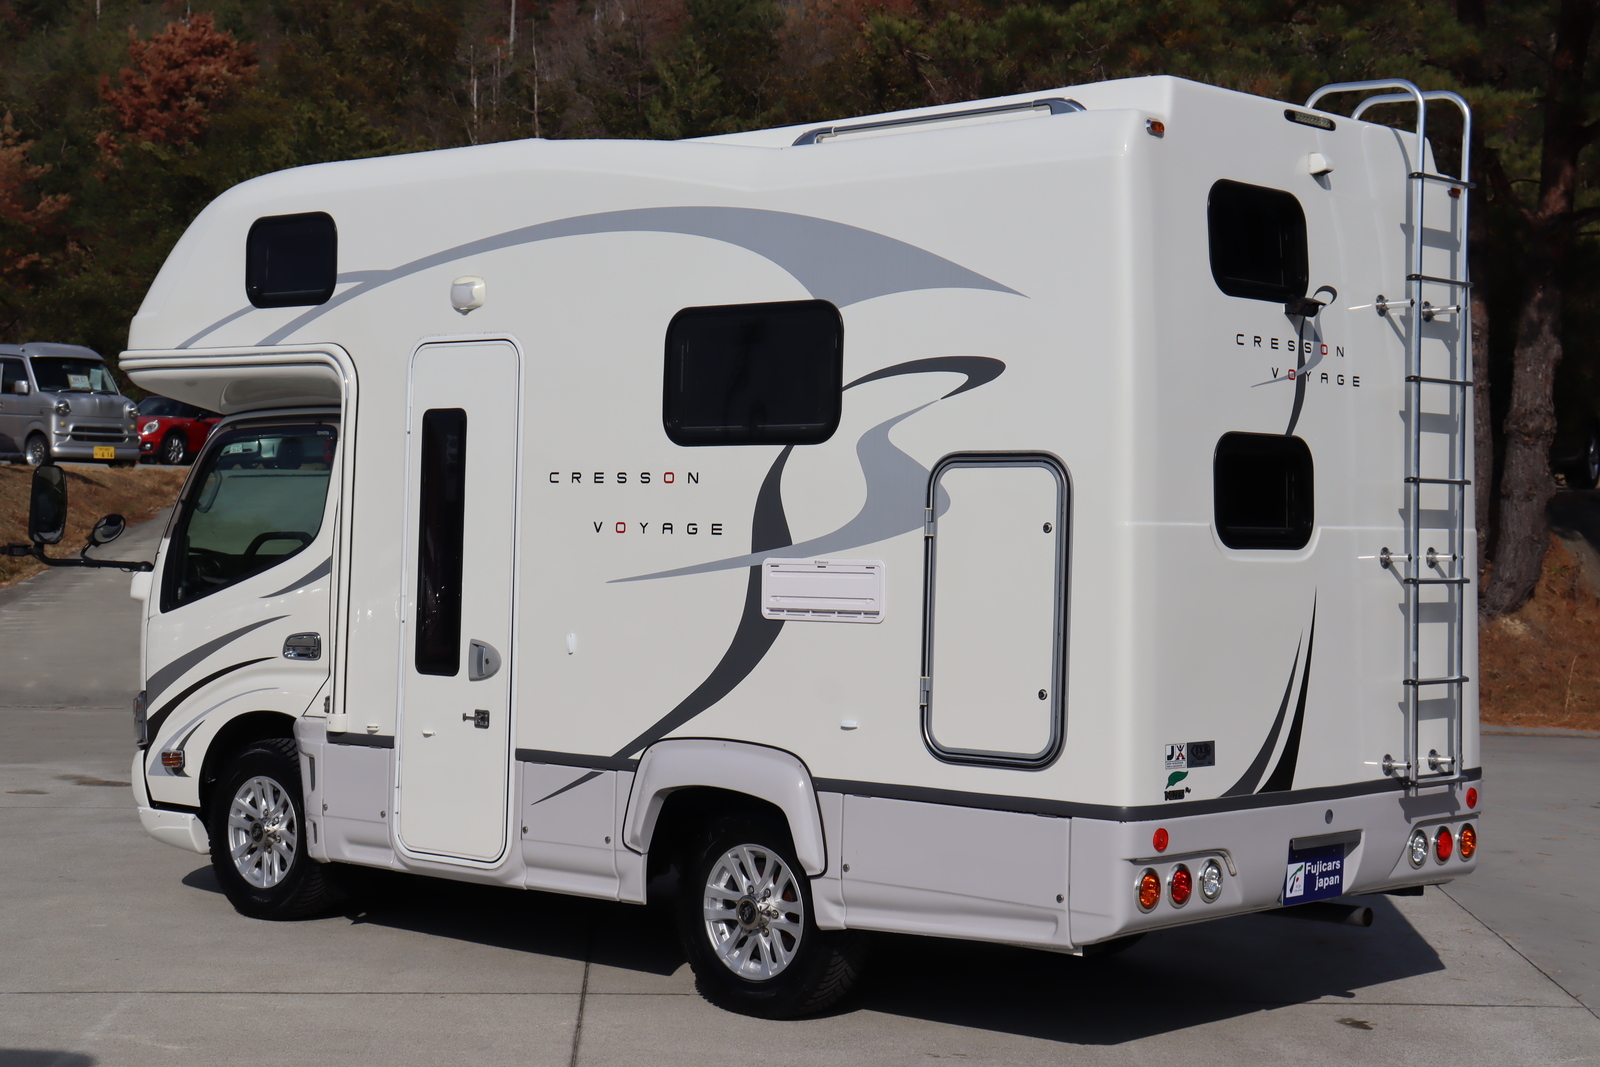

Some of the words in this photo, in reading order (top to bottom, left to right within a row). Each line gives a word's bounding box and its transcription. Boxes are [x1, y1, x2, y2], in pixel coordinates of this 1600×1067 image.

[1236, 333, 1345, 358] CRESSON
[1271, 367, 1361, 387] VOYAGE
[549, 471, 699, 484] CRESSON
[593, 521, 723, 536] VOYAGE
[1305, 859, 1341, 876] Fujicars
[1314, 875, 1340, 891] japan
